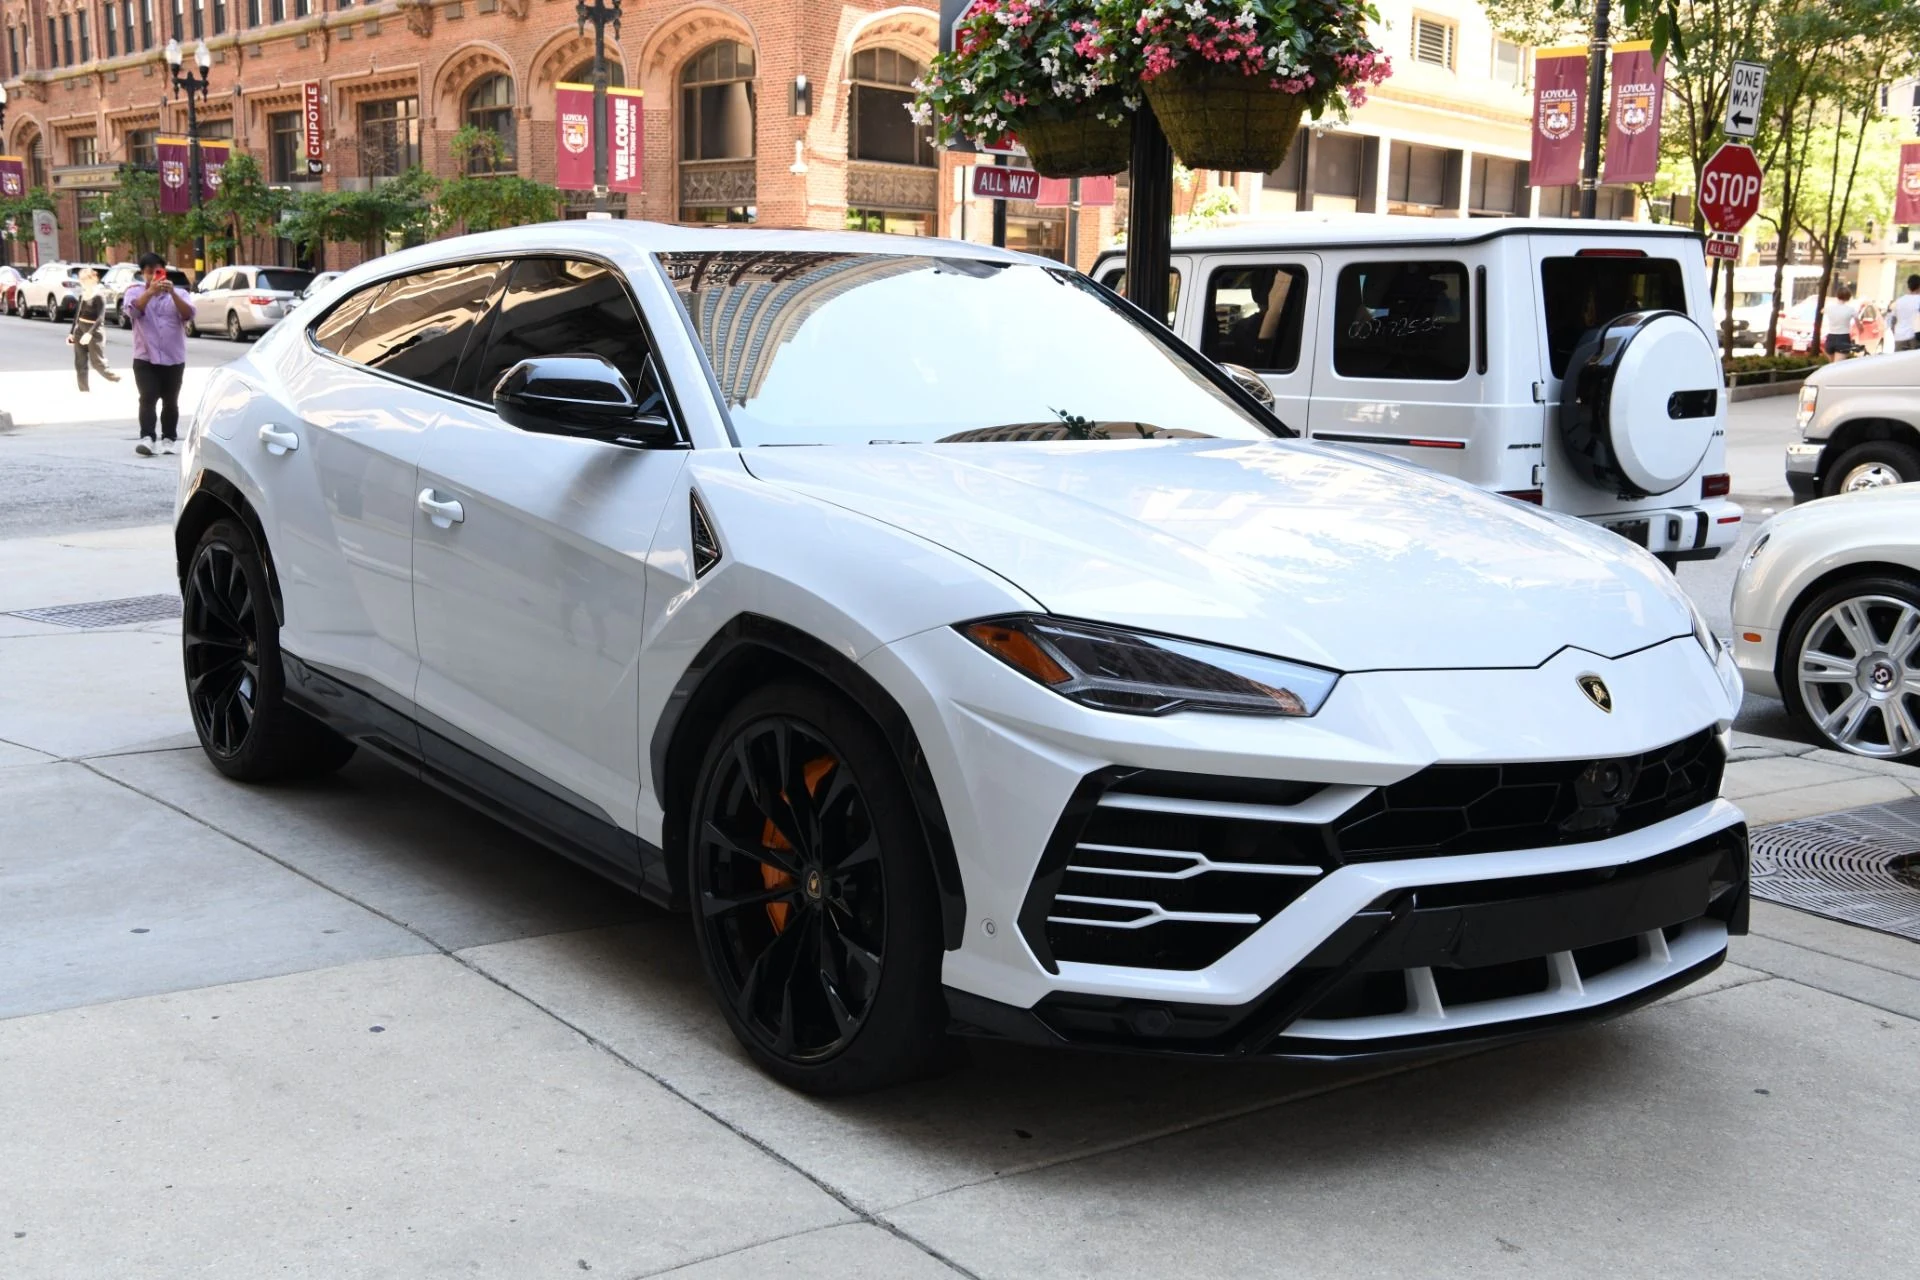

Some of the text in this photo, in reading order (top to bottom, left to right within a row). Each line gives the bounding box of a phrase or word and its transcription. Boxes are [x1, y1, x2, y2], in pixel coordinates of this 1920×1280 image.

[1736, 69, 1760, 88] ONE
[1540, 89, 1577, 99] LOYOLA
[1618, 83, 1655, 94] LOYOLA
[1733, 88, 1758, 108] WAY
[308, 87, 320, 155] CHIPOTLE
[562, 113, 588, 121] LOYOLA
[615, 98, 629, 181] WELCOME
[980, 172, 1034, 194] ALL WAY
[1703, 171, 1759, 207] STOP
[1708, 243, 1737, 257] ALL WAY
